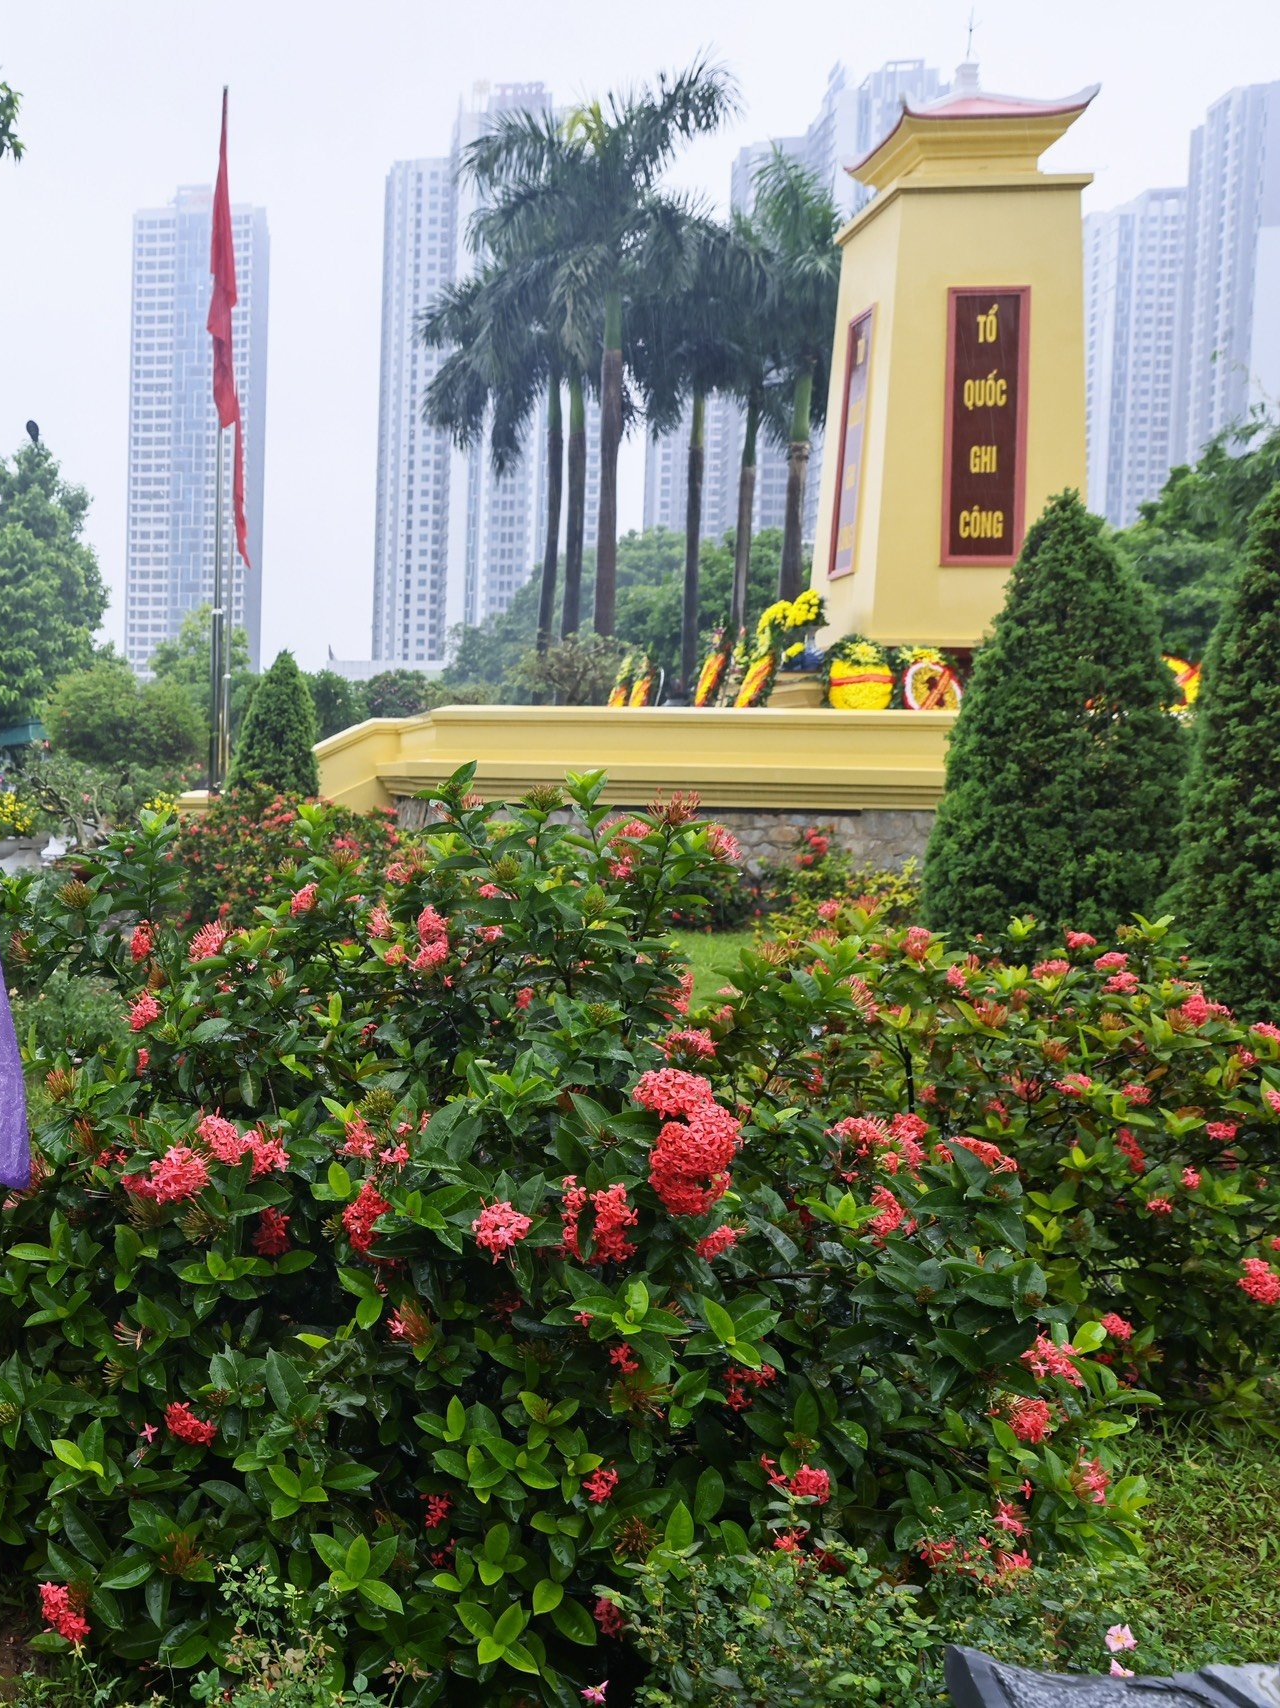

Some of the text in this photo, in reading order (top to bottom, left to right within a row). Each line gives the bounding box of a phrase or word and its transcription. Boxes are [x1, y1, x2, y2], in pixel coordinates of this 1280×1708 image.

[976, 303, 999, 343] TỔ
[963, 369, 1007, 410] QUỐC
[970, 445, 997, 473] GHI
[959, 505, 1003, 538] CÔNG
